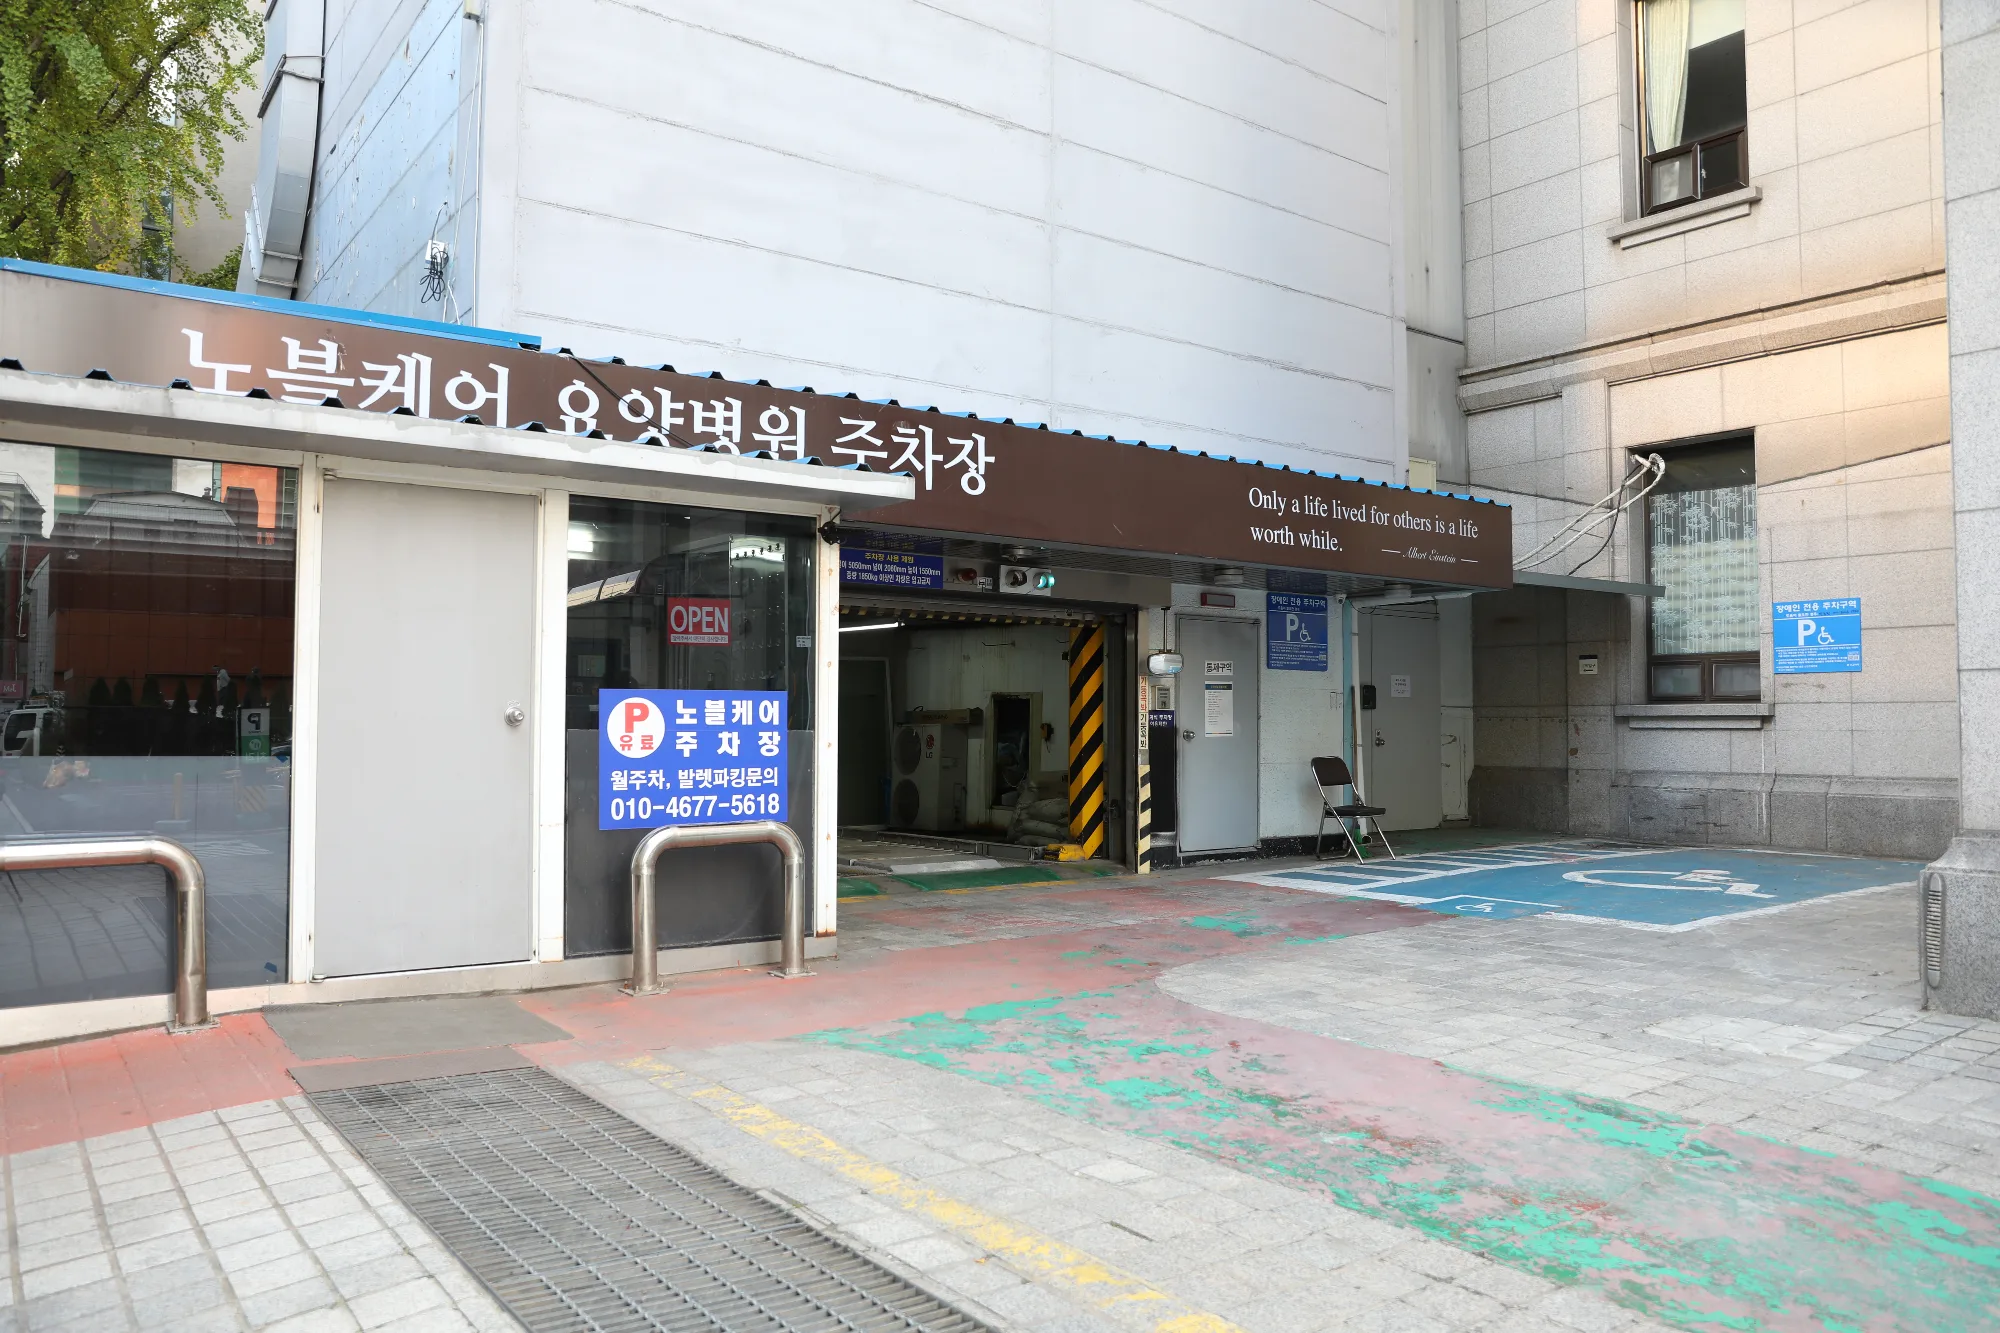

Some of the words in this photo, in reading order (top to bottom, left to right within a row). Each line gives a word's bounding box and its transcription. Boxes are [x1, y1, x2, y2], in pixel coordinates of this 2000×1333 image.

[181, 328, 510, 428] 노블케어
[548, 379, 806, 461] 요양병원
[831, 415, 995, 496] 주차장
[1248, 487, 1287, 516] Only
[1291, 497, 1301, 514] a
[1304, 494, 1328, 517] life
[1332, 499, 1366, 523] lived
[1370, 505, 1390, 527] for
[1393, 509, 1431, 532] others
[1435, 514, 1446, 534] is
[1448, 520, 1456, 536] a
[1459, 518, 1479, 539] life
[1250, 525, 1295, 546] worth
[1298, 531, 1343, 552] while.
[865, 552, 885, 562] 주차장
[1403, 546, 1427, 560] Albert
[1428, 548, 1457, 564] Einstein
[1270, 596, 1289, 605] 장애인
[1290, 597, 1302, 607] 전용
[1303, 598, 1326, 609] 주차구역
[1776, 604, 1801, 614] 장애인
[1803, 602, 1820, 612] 전용
[1822, 600, 1857, 610] 주차구역
[670, 605, 729, 633] OPEN
[1286, 614, 1299, 641] P
[1797, 620, 1816, 646] P
[1206, 662, 1233, 674] 통제구역
[624, 702, 650, 733] P
[676, 699, 780, 726] 노블케어
[620, 735, 654, 751] 유료
[610, 770, 671, 791] 월주차,
[678, 767, 778, 789] 발렛파킹문의
[610, 793, 780, 820] 010-4677-5618
